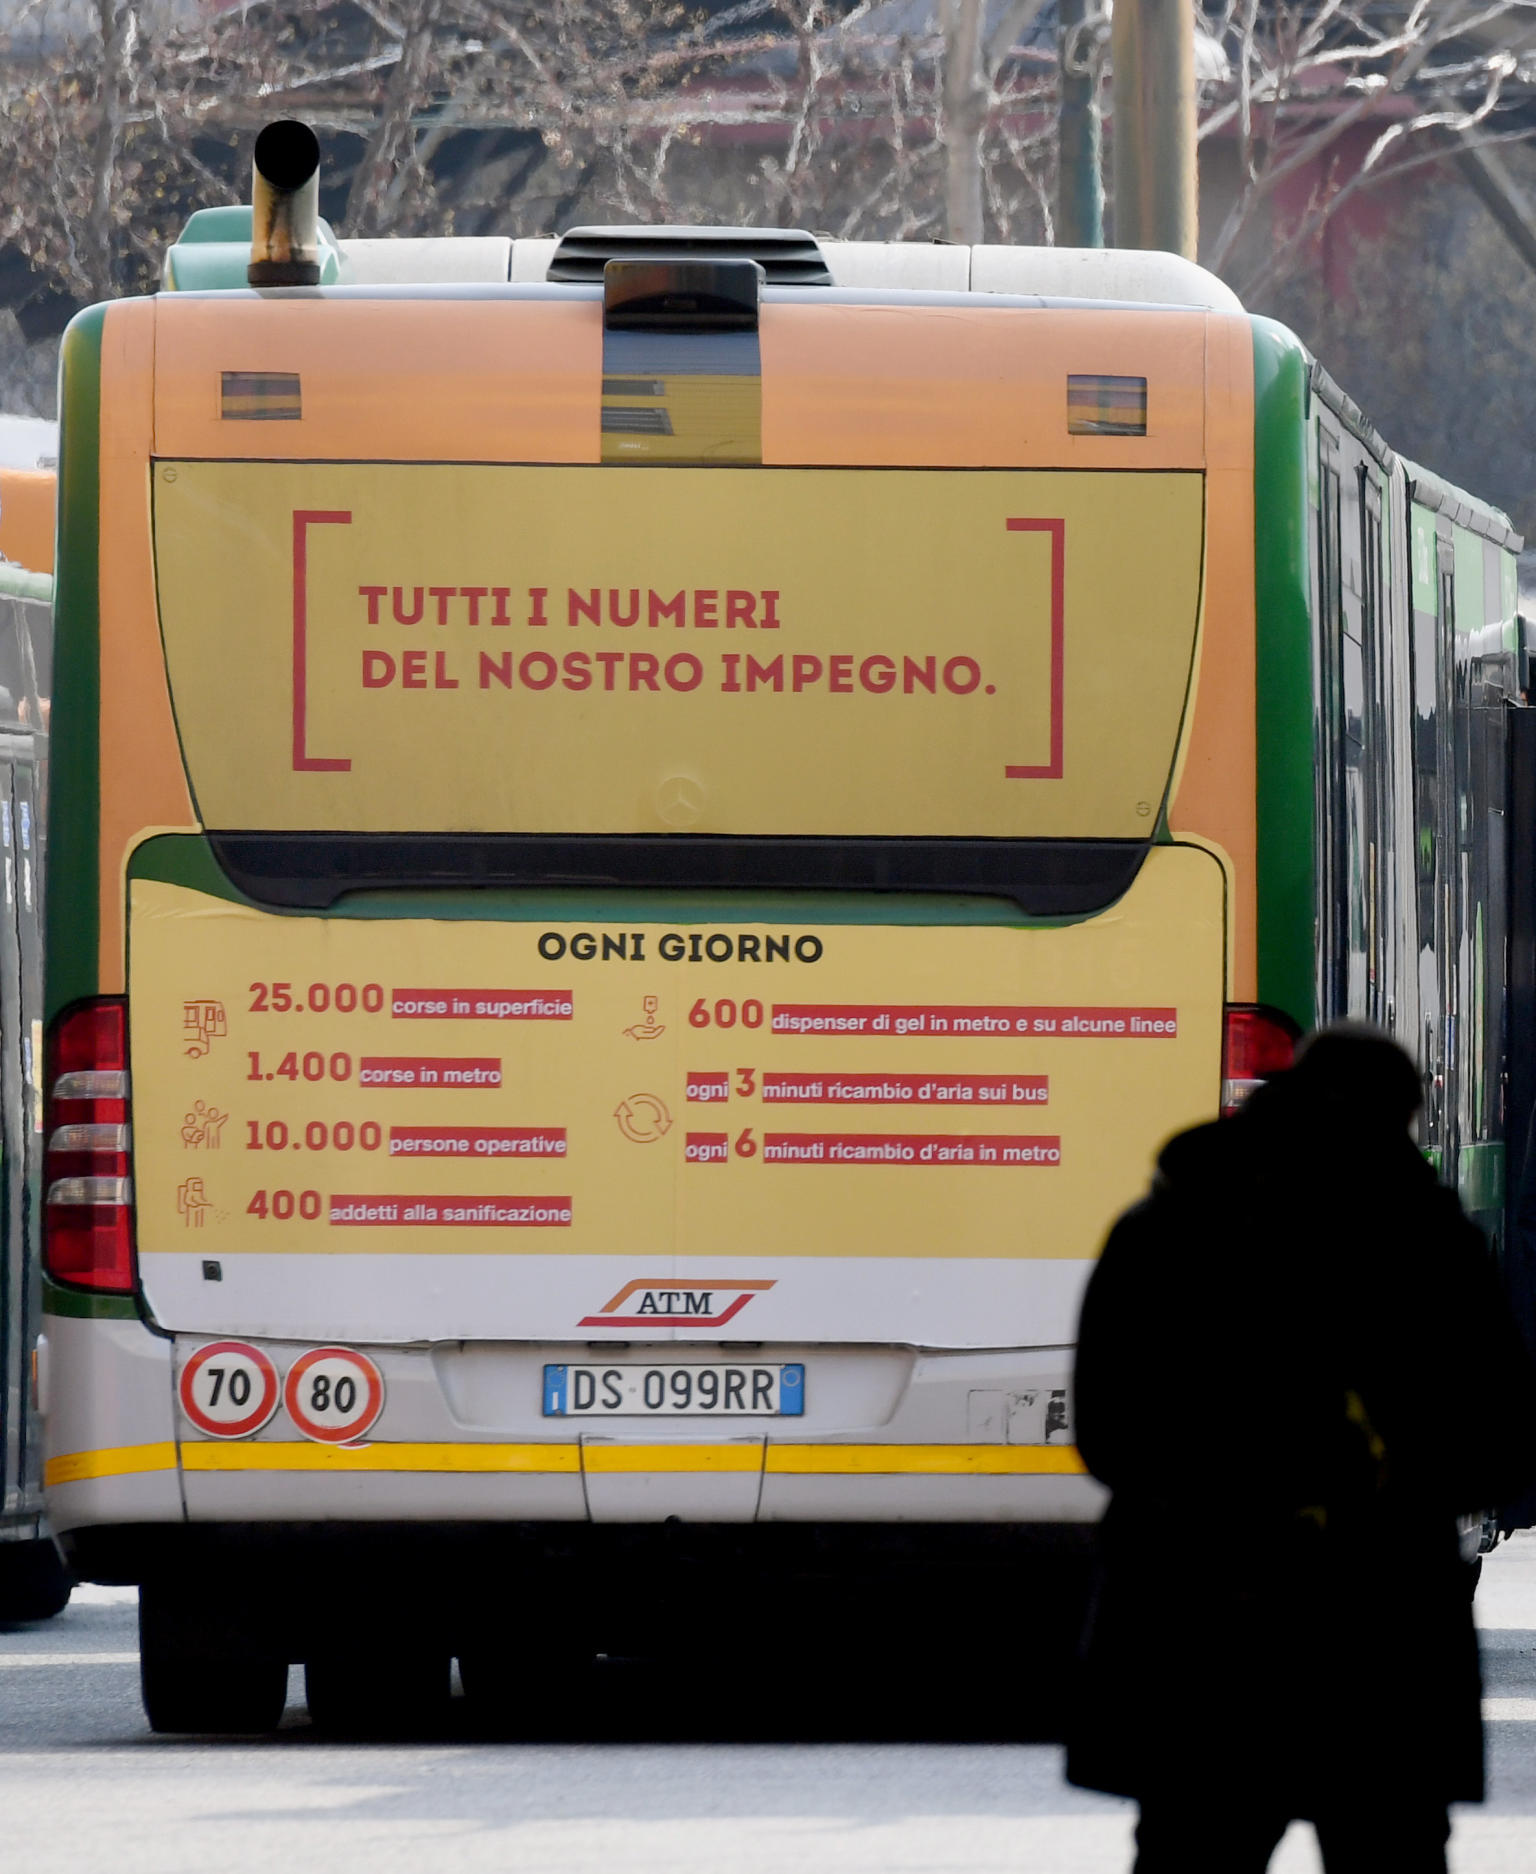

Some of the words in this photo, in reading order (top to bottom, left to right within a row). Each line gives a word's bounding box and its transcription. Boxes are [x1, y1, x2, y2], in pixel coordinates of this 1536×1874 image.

[359, 586, 511, 626] TUTTI
[528, 588, 548, 626] I
[567, 588, 781, 629] NUMERI
[361, 650, 459, 689] DEL
[479, 651, 704, 693] NOSTRO
[721, 654, 997, 695] IMPEGNO.
[537, 931, 646, 962] OGNI
[657, 932, 823, 963] GIORNO
[249, 982, 384, 1013] 25.000
[392, 999, 447, 1014] corse
[452, 997, 470, 1014] in
[476, 997, 572, 1018] superficie
[688, 998, 764, 1028] 600
[772, 1013, 867, 1032] dispenser
[872, 1014, 890, 1030] di
[895, 1014, 925, 1034] gel
[930, 1014, 948, 1031] in
[953, 1016, 1010, 1032] metro
[1016, 1018, 1028, 1031] e
[1033, 1018, 1056, 1032] su
[1061, 1016, 1125, 1033] alcune
[1130, 1016, 1176, 1034] linee
[246, 1051, 352, 1082] 1.400
[360, 1068, 414, 1083] corse
[420, 1066, 438, 1082] in
[443, 1069, 501, 1084] metro
[686, 1082, 729, 1101] ogni
[735, 1068, 756, 1098] 3
[763, 1082, 822, 1098] minuti
[828, 1083, 912, 1100] ricambio
[918, 1083, 973, 1100] d'aria
[978, 1084, 1006, 1101] sui
[1012, 1084, 1048, 1101] bus
[246, 1121, 382, 1151] 10.000
[390, 1137, 469, 1154] persone
[474, 1136, 567, 1155] operative
[686, 1141, 728, 1161] ogni
[734, 1128, 757, 1158] 6
[764, 1142, 824, 1159] minuti
[829, 1143, 913, 1160] ricambio
[919, 1144, 974, 1161] d'aria
[979, 1145, 997, 1160] in
[1003, 1147, 1060, 1161] metro
[246, 1190, 322, 1220] 400
[330, 1204, 398, 1221] addetti
[403, 1205, 438, 1222] alla
[443, 1205, 571, 1223] sanificazione
[636, 1292, 713, 1315] ATM
[207, 1369, 251, 1407] 70
[311, 1374, 356, 1413] 80
[574, 1370, 624, 1410] DS
[644, 1369, 774, 1410] 099RR
